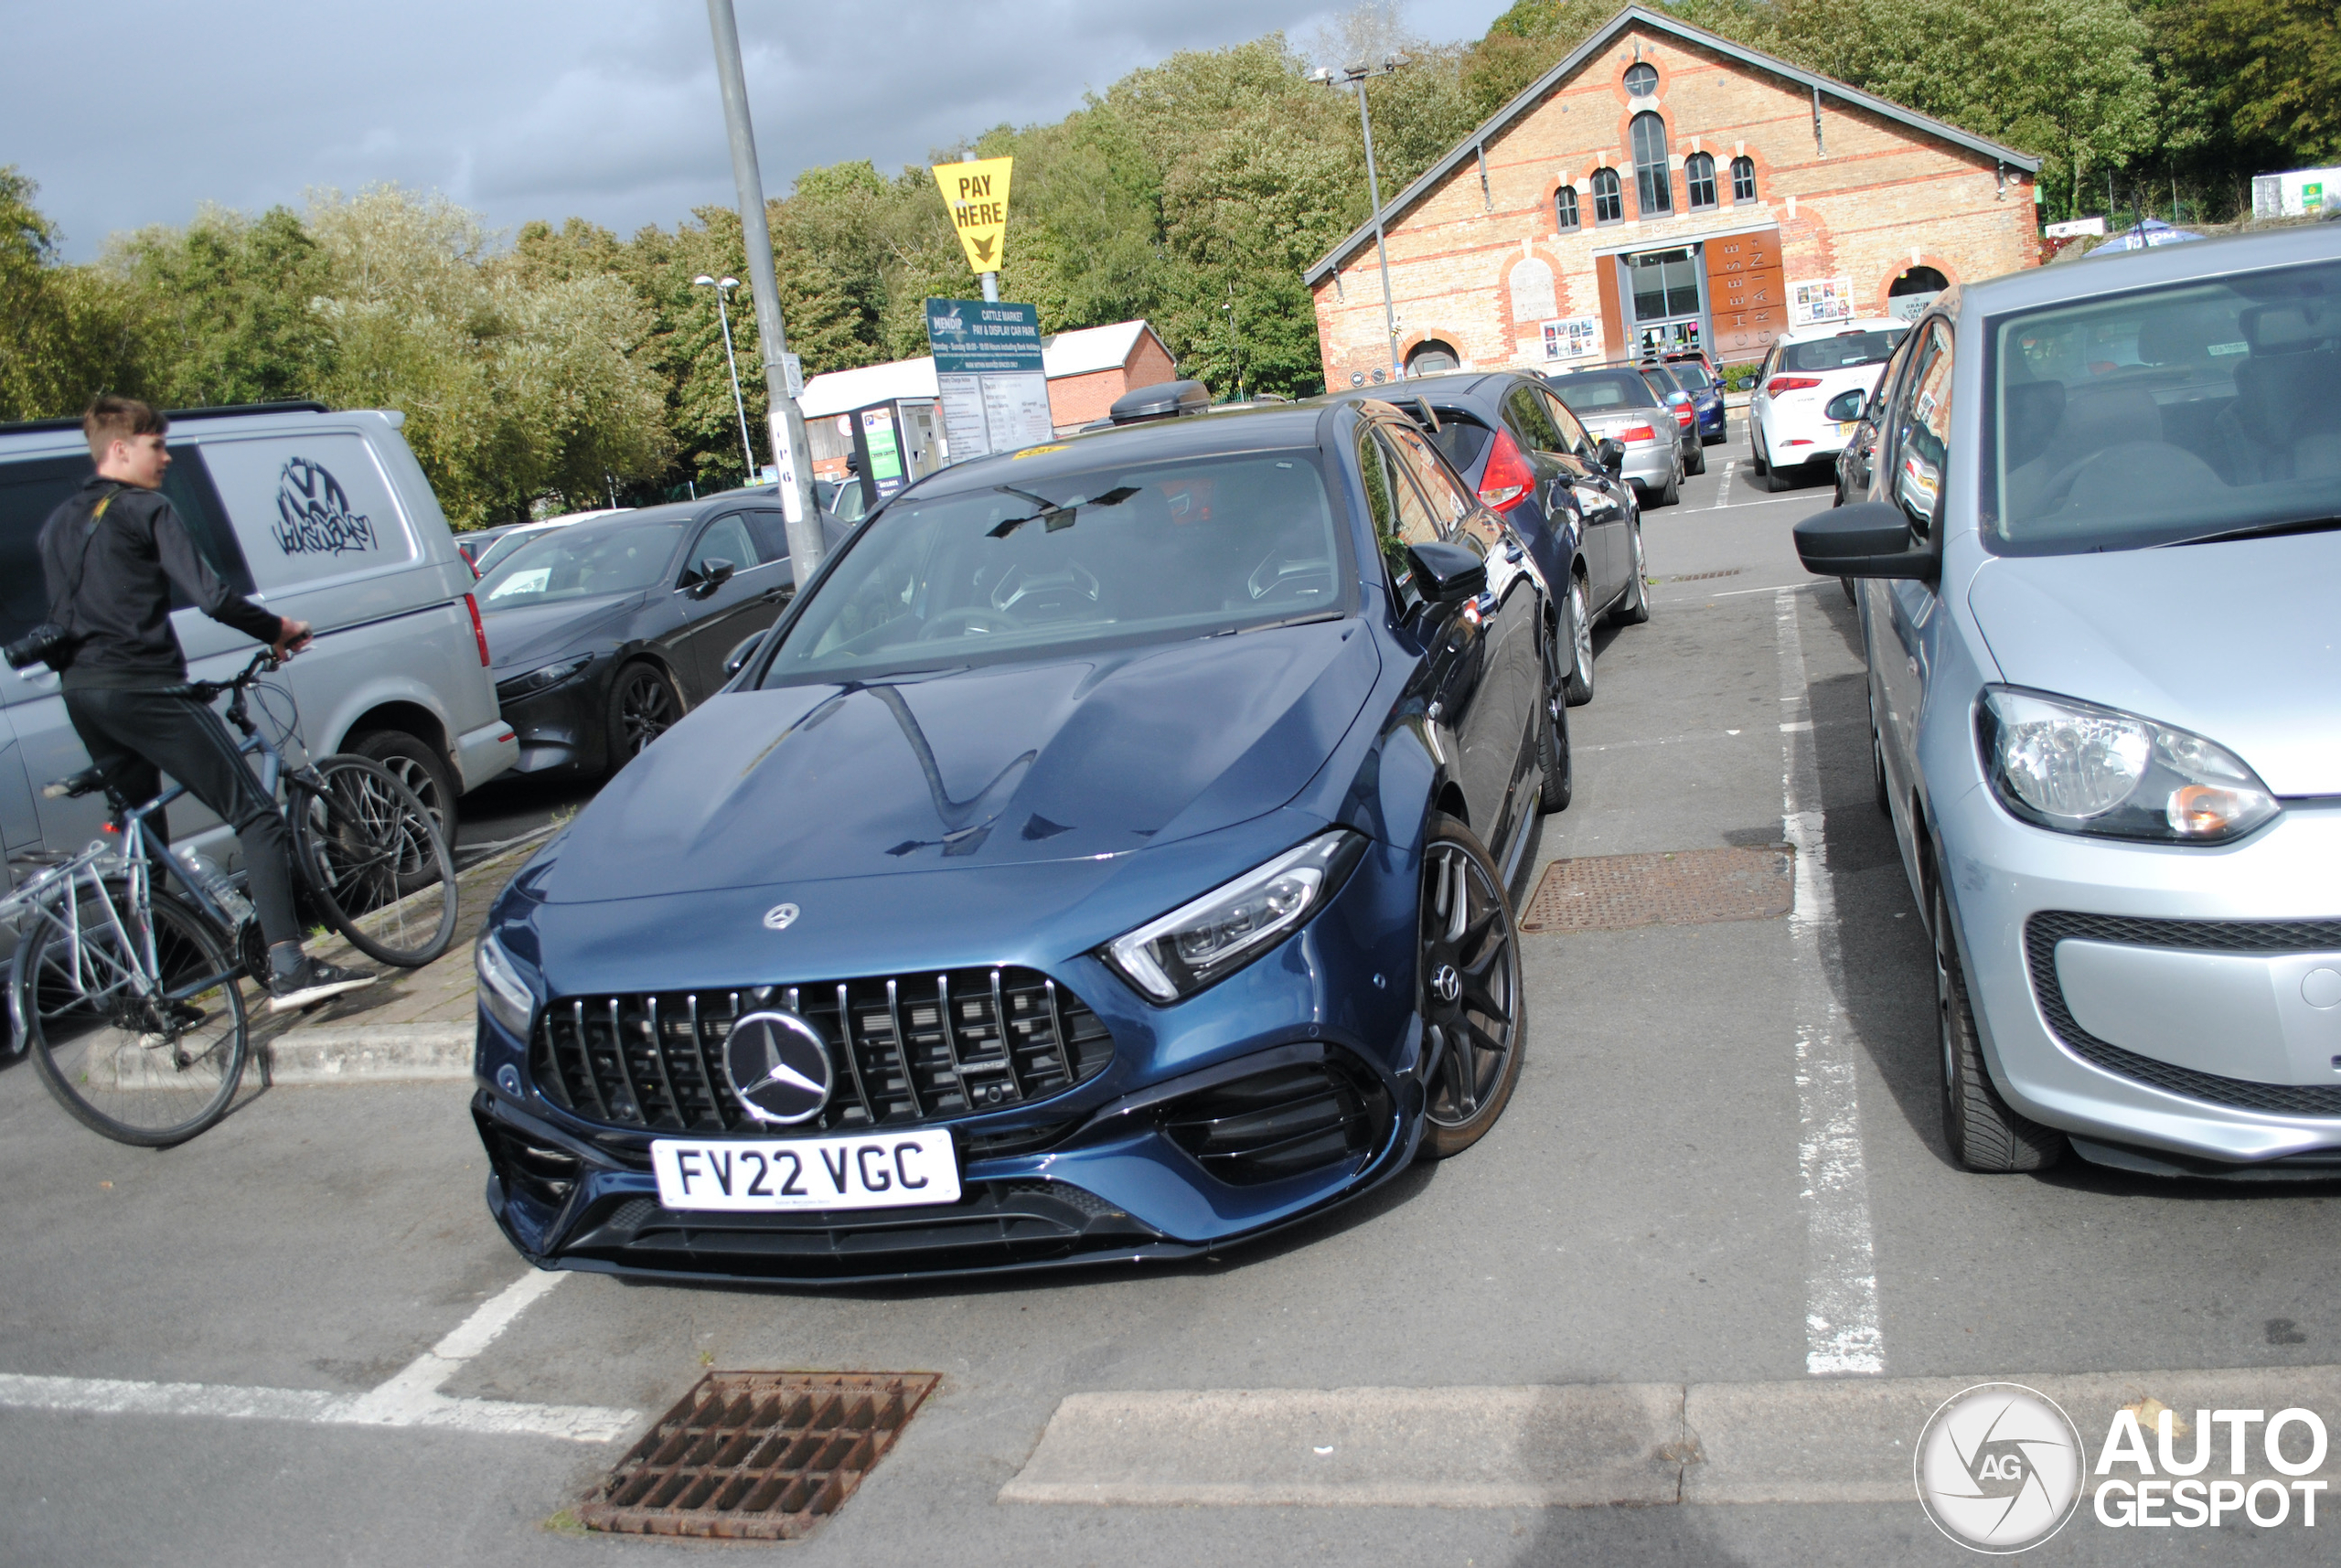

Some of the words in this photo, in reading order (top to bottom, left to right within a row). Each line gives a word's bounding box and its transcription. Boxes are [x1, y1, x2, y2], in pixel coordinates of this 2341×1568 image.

[958, 175, 991, 198] PAY
[956, 202, 1004, 229] HERE
[1725, 242, 1748, 347] CHEESE
[1748, 251, 1771, 344] GRAIN
[934, 316, 963, 330] MENDIP
[981, 310, 1001, 321] CATTLE
[1001, 311, 1023, 322] MARKET
[972, 325, 983, 336] PAY
[983, 325, 989, 336] &
[989, 325, 1010, 336] DISPLAY
[1010, 325, 1021, 336] CAR
[1021, 326, 1036, 336] PARK
[675, 1148, 808, 1197] FV22
[819, 1141, 929, 1194] VGC
